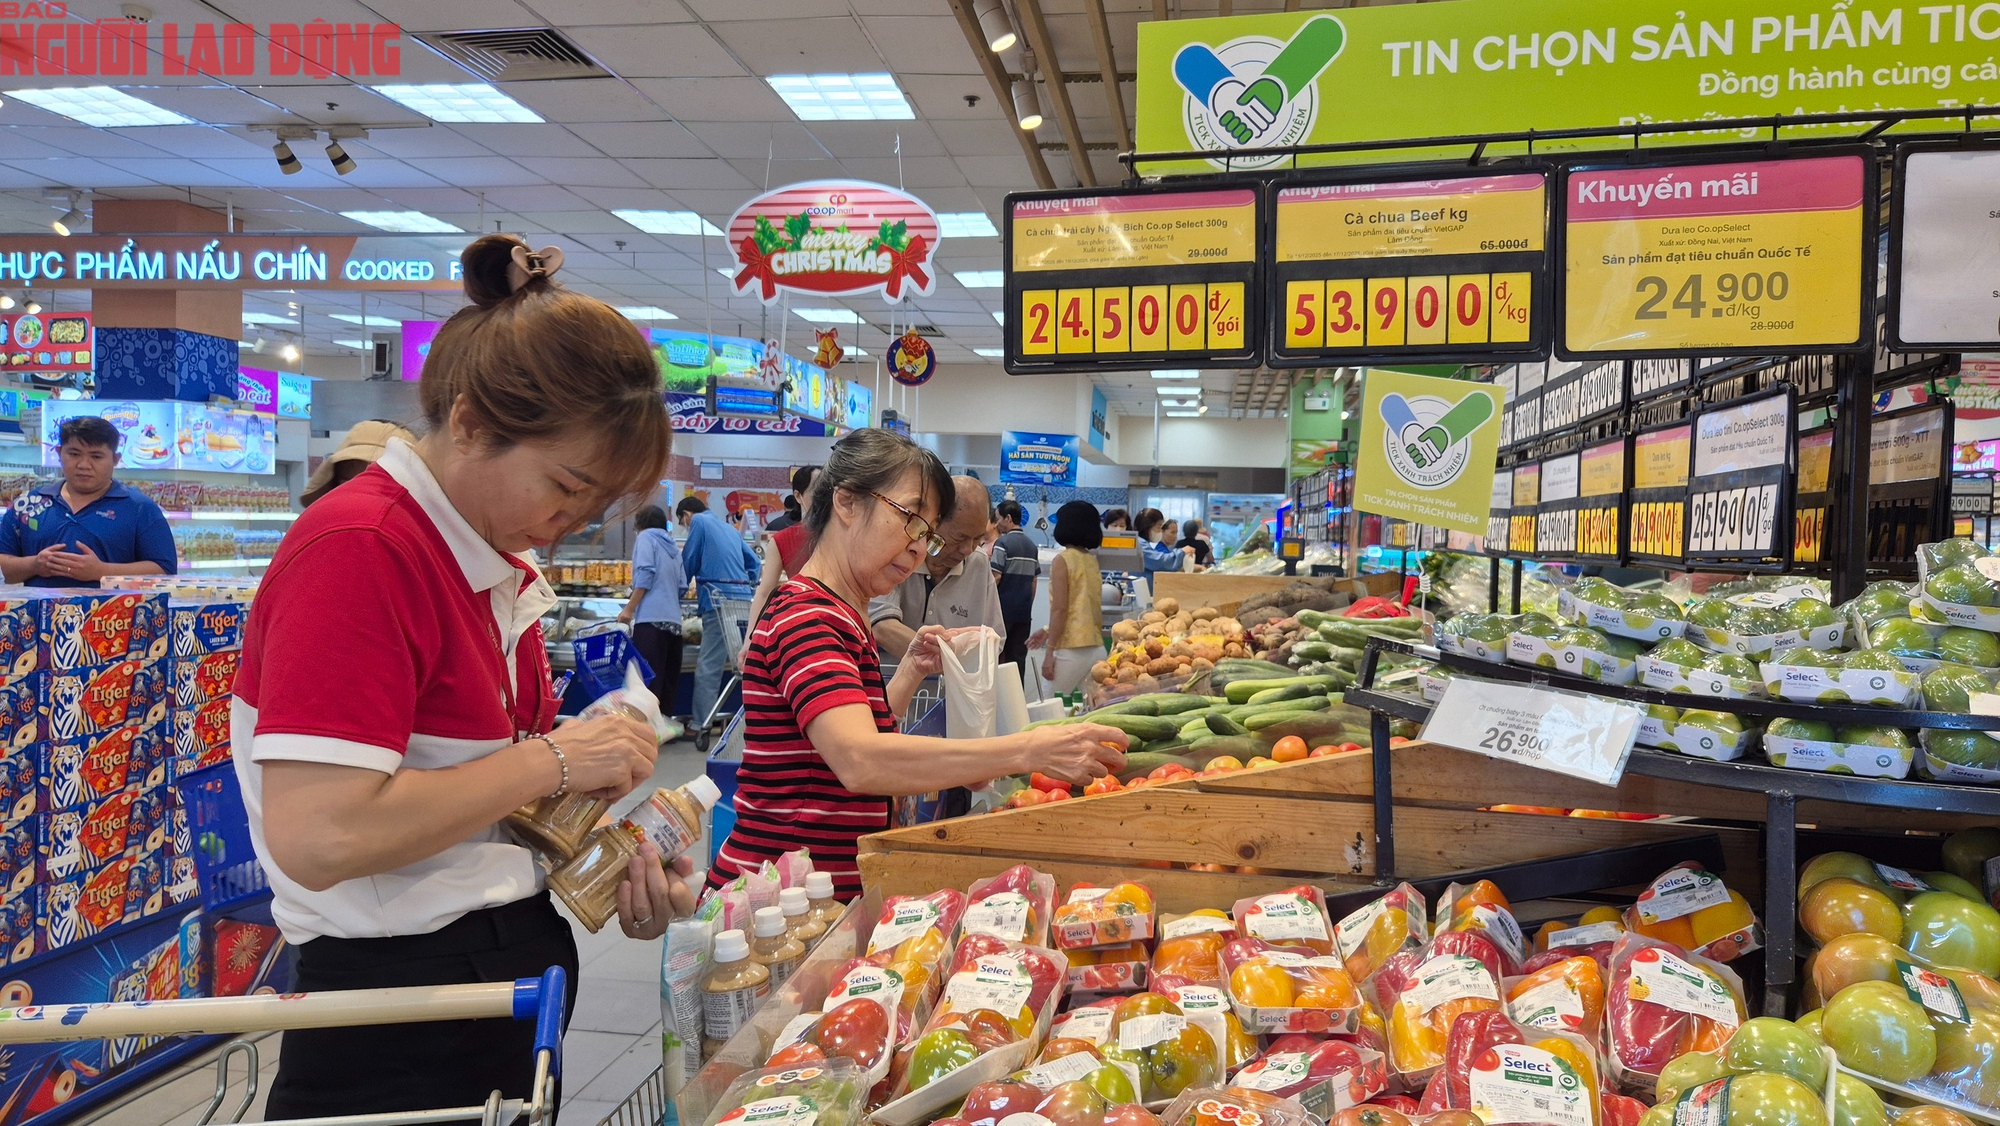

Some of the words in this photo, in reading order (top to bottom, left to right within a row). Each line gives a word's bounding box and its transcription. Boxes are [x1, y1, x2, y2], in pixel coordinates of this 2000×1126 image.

[1382, 39, 1459, 77] TIN
[1472, 28, 1616, 76] CHỌN
[1631, 10, 1734, 62] SẢN
[1750, 0, 1902, 54] PHẨM
[1699, 68, 1779, 98] Đồng
[1788, 64, 1864, 91] hành
[1872, 61, 1951, 89] cùng
[1194, 113, 1210, 141] TICK
[1281, 108, 1307, 146] NHIỆM
[1578, 173, 1692, 207] Khuyến
[1701, 171, 1758, 198] mãi
[1344, 212, 1364, 225] Cà
[1369, 211, 1405, 224] chua
[1410, 208, 1446, 222] Beef
[1449, 207, 1468, 222] kg
[1026, 228, 1038, 237] Cà
[1080, 226, 1095, 236] cây
[1146, 221, 1173, 231] Co.op
[1175, 219, 1204, 229] Select
[1206, 218, 1228, 229] 300g
[1661, 226, 1681, 235] Dưa
[1682, 225, 1696, 234] leo
[1697, 223, 1751, 235] Co.opSelect
[801, 232, 868, 258] merry
[1480, 239, 1528, 251] 65.000đ
[1659, 238, 1674, 247] Xuất
[1687, 237, 1706, 247] Đồng
[1722, 236, 1736, 245] Việt
[1736, 236, 1753, 244] Nam
[75, 238, 164, 280] PHẨM
[176, 240, 241, 280] NẤU
[254, 245, 327, 281] CHÍN
[345, 260, 434, 281] COOKED
[1188, 247, 1228, 258] 29.000đ
[1602, 253, 1625, 265] Sản
[1628, 251, 1663, 266] phẩm
[1665, 251, 1686, 265] đạt
[1688, 250, 1712, 262] tiêu
[1715, 246, 1754, 260] chuẩn
[1757, 245, 1792, 259] Quốc
[1795, 244, 1811, 257] Tế
[771, 250, 892, 275] CHRISTMAS
[1294, 282, 1482, 336] 53.900
[1725, 303, 1761, 320] đ/kg
[1029, 294, 1199, 344] 24.500
[1750, 320, 1794, 331] 28.900đ
[670, 412, 719, 433] ady
[723, 417, 751, 431] to
[756, 416, 801, 432] eat
[1733, 415, 1769, 434] Co.opSelect
[1770, 412, 1785, 428] 300g
[1757, 436, 1768, 446] Quốc
[1893, 434, 1910, 449] 500g
[1008, 450, 1020, 459] HẢI
[1020, 450, 1034, 459] SẢN
[1390, 441, 1400, 460] TICK
[1397, 460, 1417, 479] XANH
[1417, 471, 1444, 483] TRÁCH
[1444, 452, 1463, 476] NHIỆM
[1385, 488, 1398, 497] TIN
[1397, 491, 1419, 501] CHỌN
[1419, 494, 1434, 504] SẢN
[1435, 497, 1457, 508] PHẨM
[1363, 494, 1384, 506] TICK
[1384, 498, 1411, 511] XANH
[1412, 502, 1445, 518] TRÁCH
[1446, 511, 1479, 525] NHIỆM
[1692, 496, 1757, 539] 25.900
[1632, 508, 1672, 544] 26.900
[201, 609, 239, 636] Tiger
[1593, 611, 1620, 624] Select
[1944, 609, 1977, 621] Select
[92, 612, 132, 639] Tiger
[1512, 639, 1533, 650] Select
[1774, 636, 1796, 646] Select
[204, 658, 236, 682] Tiger
[1649, 664, 1674, 678] Select
[1786, 672, 1819, 682] Select
[90, 683, 131, 709] Tiger
[1506, 708, 1520, 718] baby
[1525, 712, 1540, 720] màu
[1497, 720, 1508, 728] Sản
[1508, 722, 1525, 732] phẩm
[1792, 746, 1825, 757] Select
[89, 750, 130, 775] Tiger
[1950, 769, 1984, 780] Select
[89, 812, 129, 839] Tiger
[1657, 875, 1692, 890] Select
[87, 880, 127, 908] Tiger
[896, 907, 924, 916] Select
[1264, 901, 1296, 912] Select
[1067, 928, 1091, 937] Select
[980, 964, 1013, 976] Select
[849, 975, 881, 985] Select
[1183, 992, 1218, 1001] Select
[1259, 1015, 1288, 1023] Select
[1504, 1056, 1552, 1073] Select
[750, 1102, 791, 1114] Select
